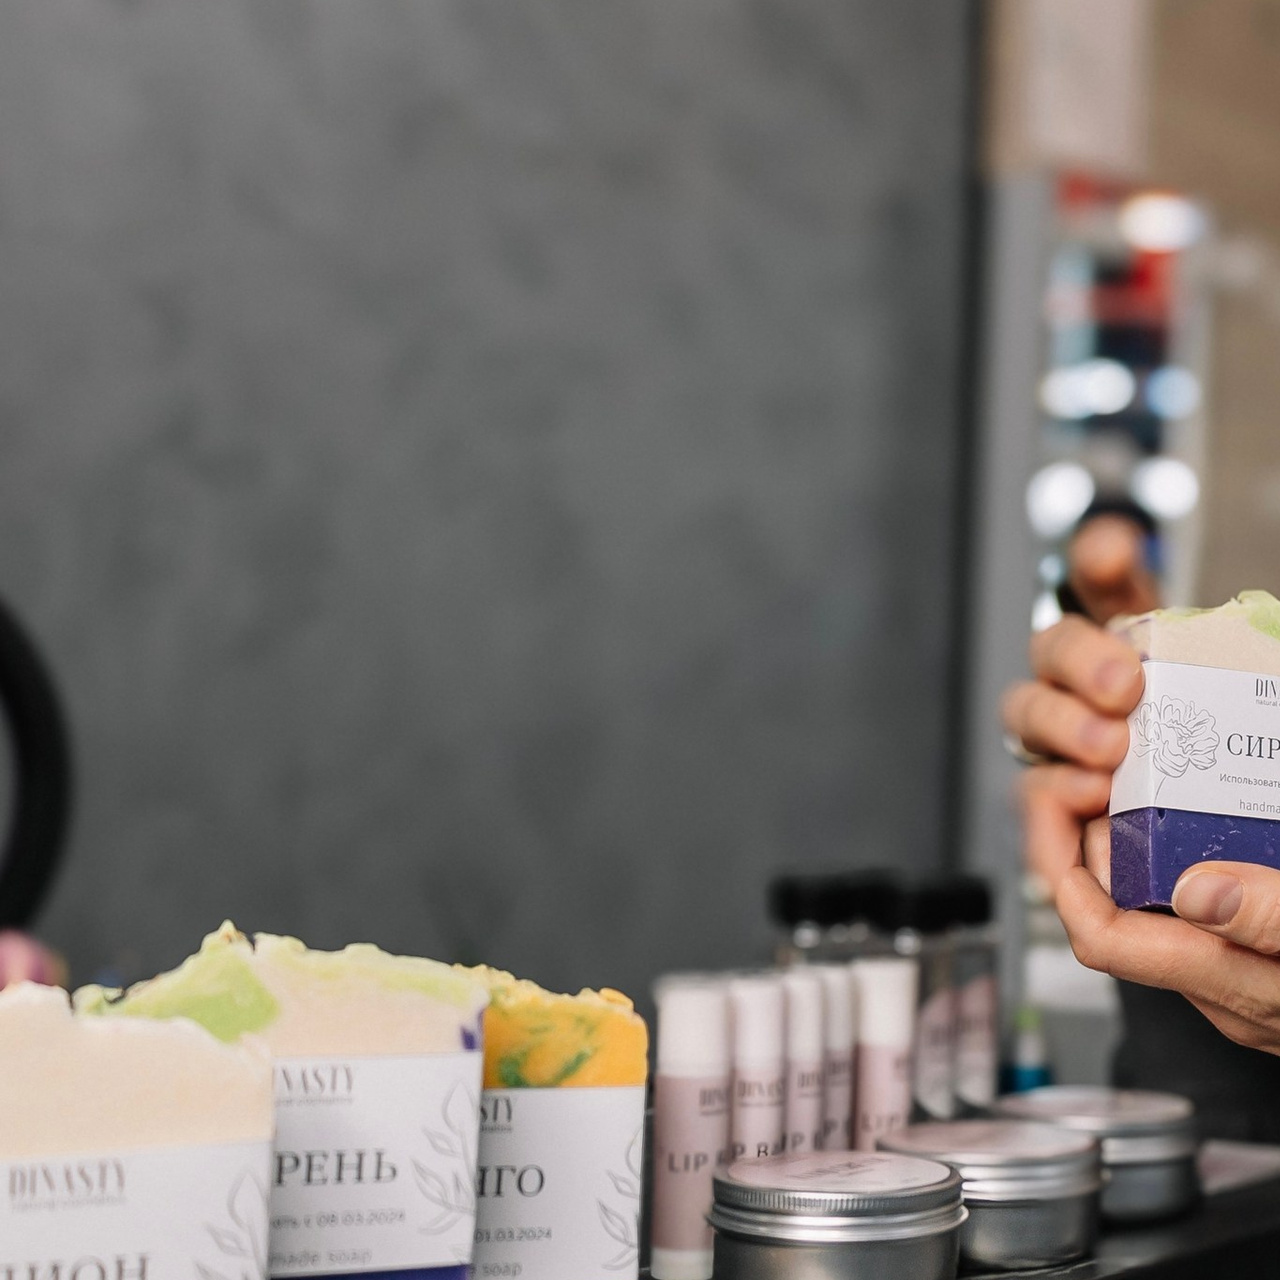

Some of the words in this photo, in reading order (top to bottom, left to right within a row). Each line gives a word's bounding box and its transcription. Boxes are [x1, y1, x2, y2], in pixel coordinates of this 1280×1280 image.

[1255, 699, 1278, 707] natural
[8, 1157, 127, 1199] DINASTY
[274, 1146, 398, 1188] РЕНЬ
